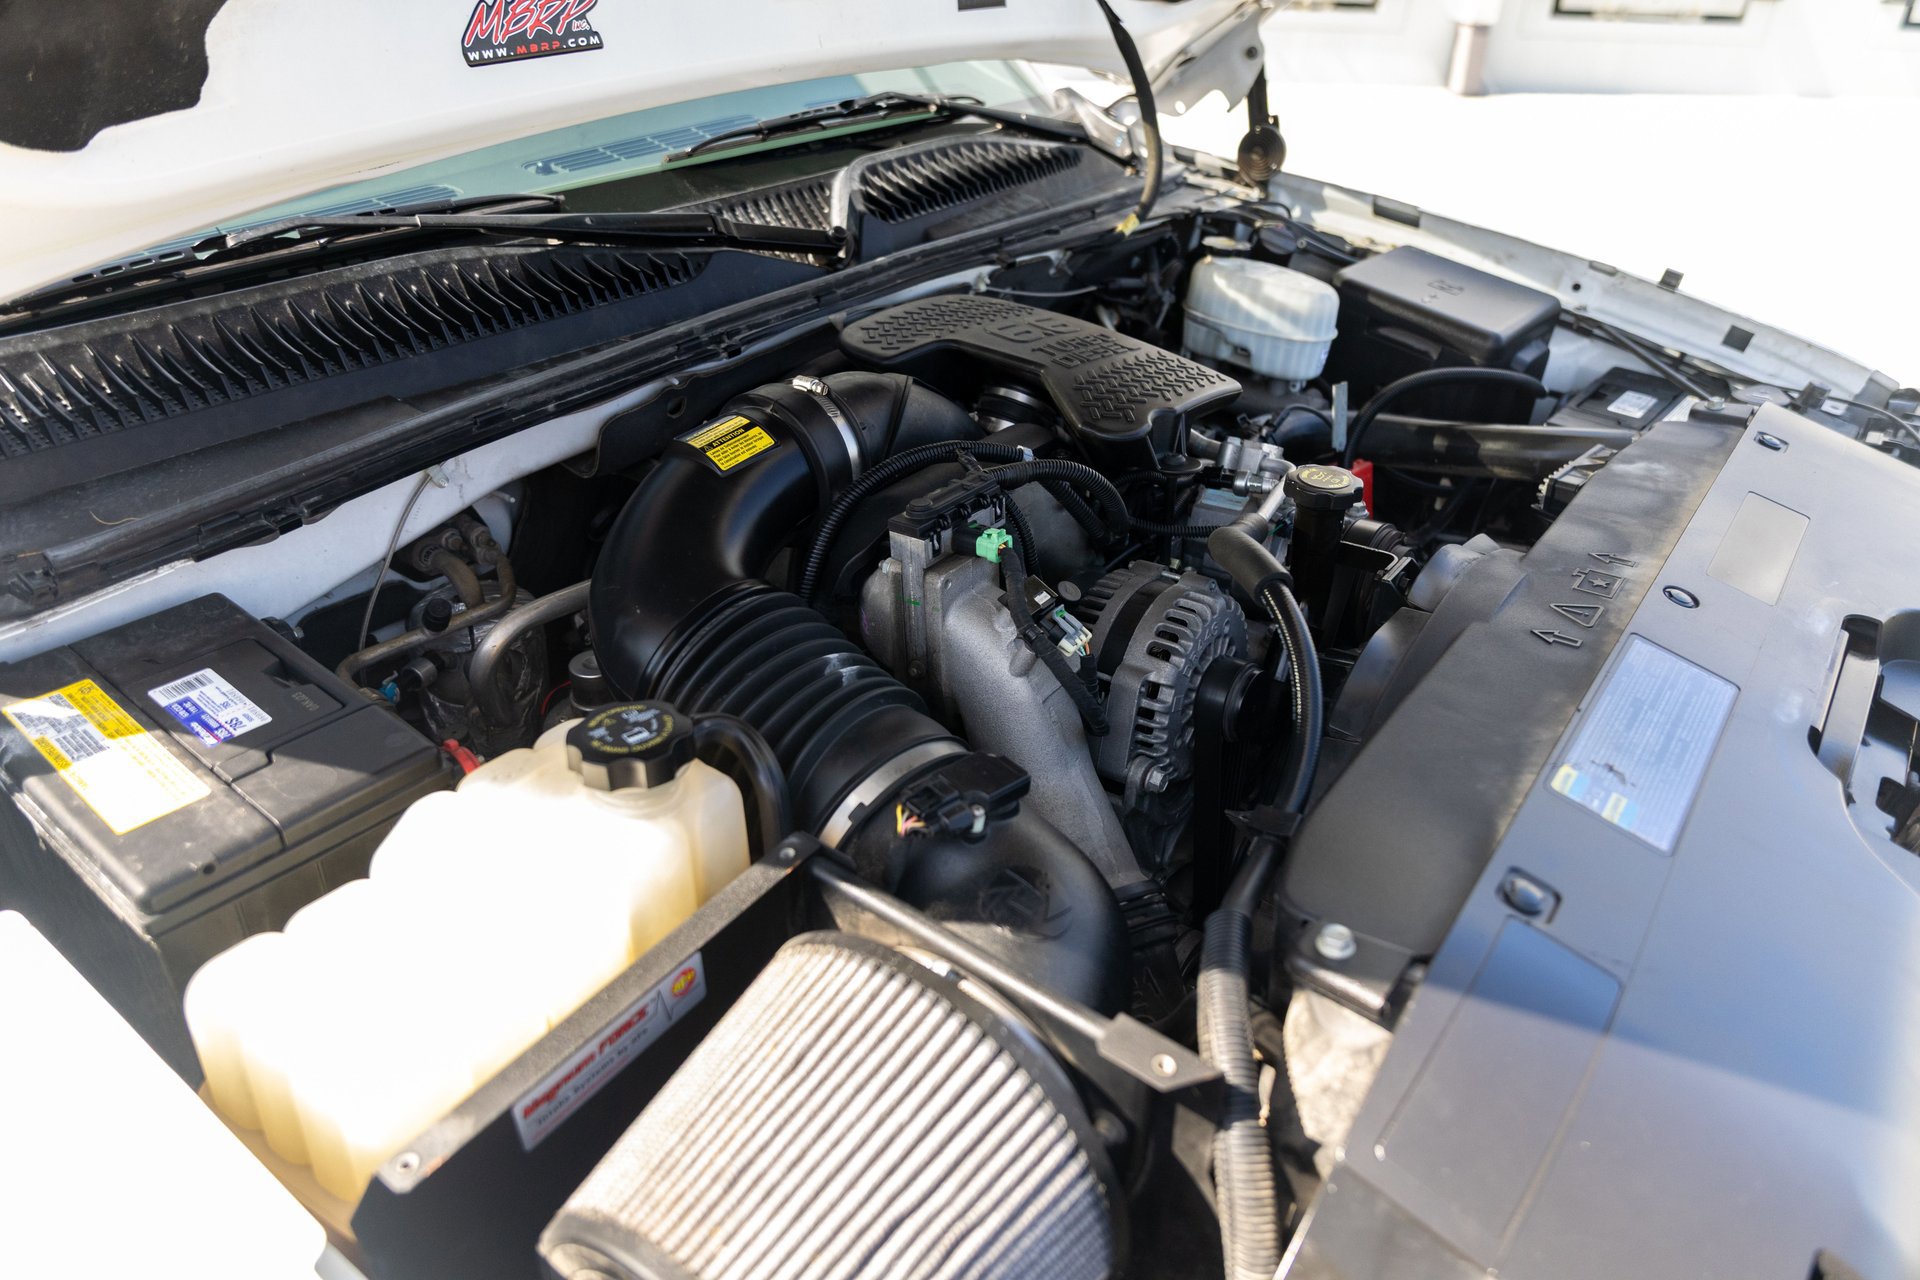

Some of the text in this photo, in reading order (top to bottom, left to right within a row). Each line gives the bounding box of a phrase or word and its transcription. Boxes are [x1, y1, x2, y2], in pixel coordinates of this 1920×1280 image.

[464, 0, 597, 47] MBRP
[467, 35, 600, 61] WWW.MBRP.COM
[1031, 333, 1116, 357] TURBO
[1052, 343, 1141, 369] DIESEL
[712, 428, 745, 447] ATTENTION
